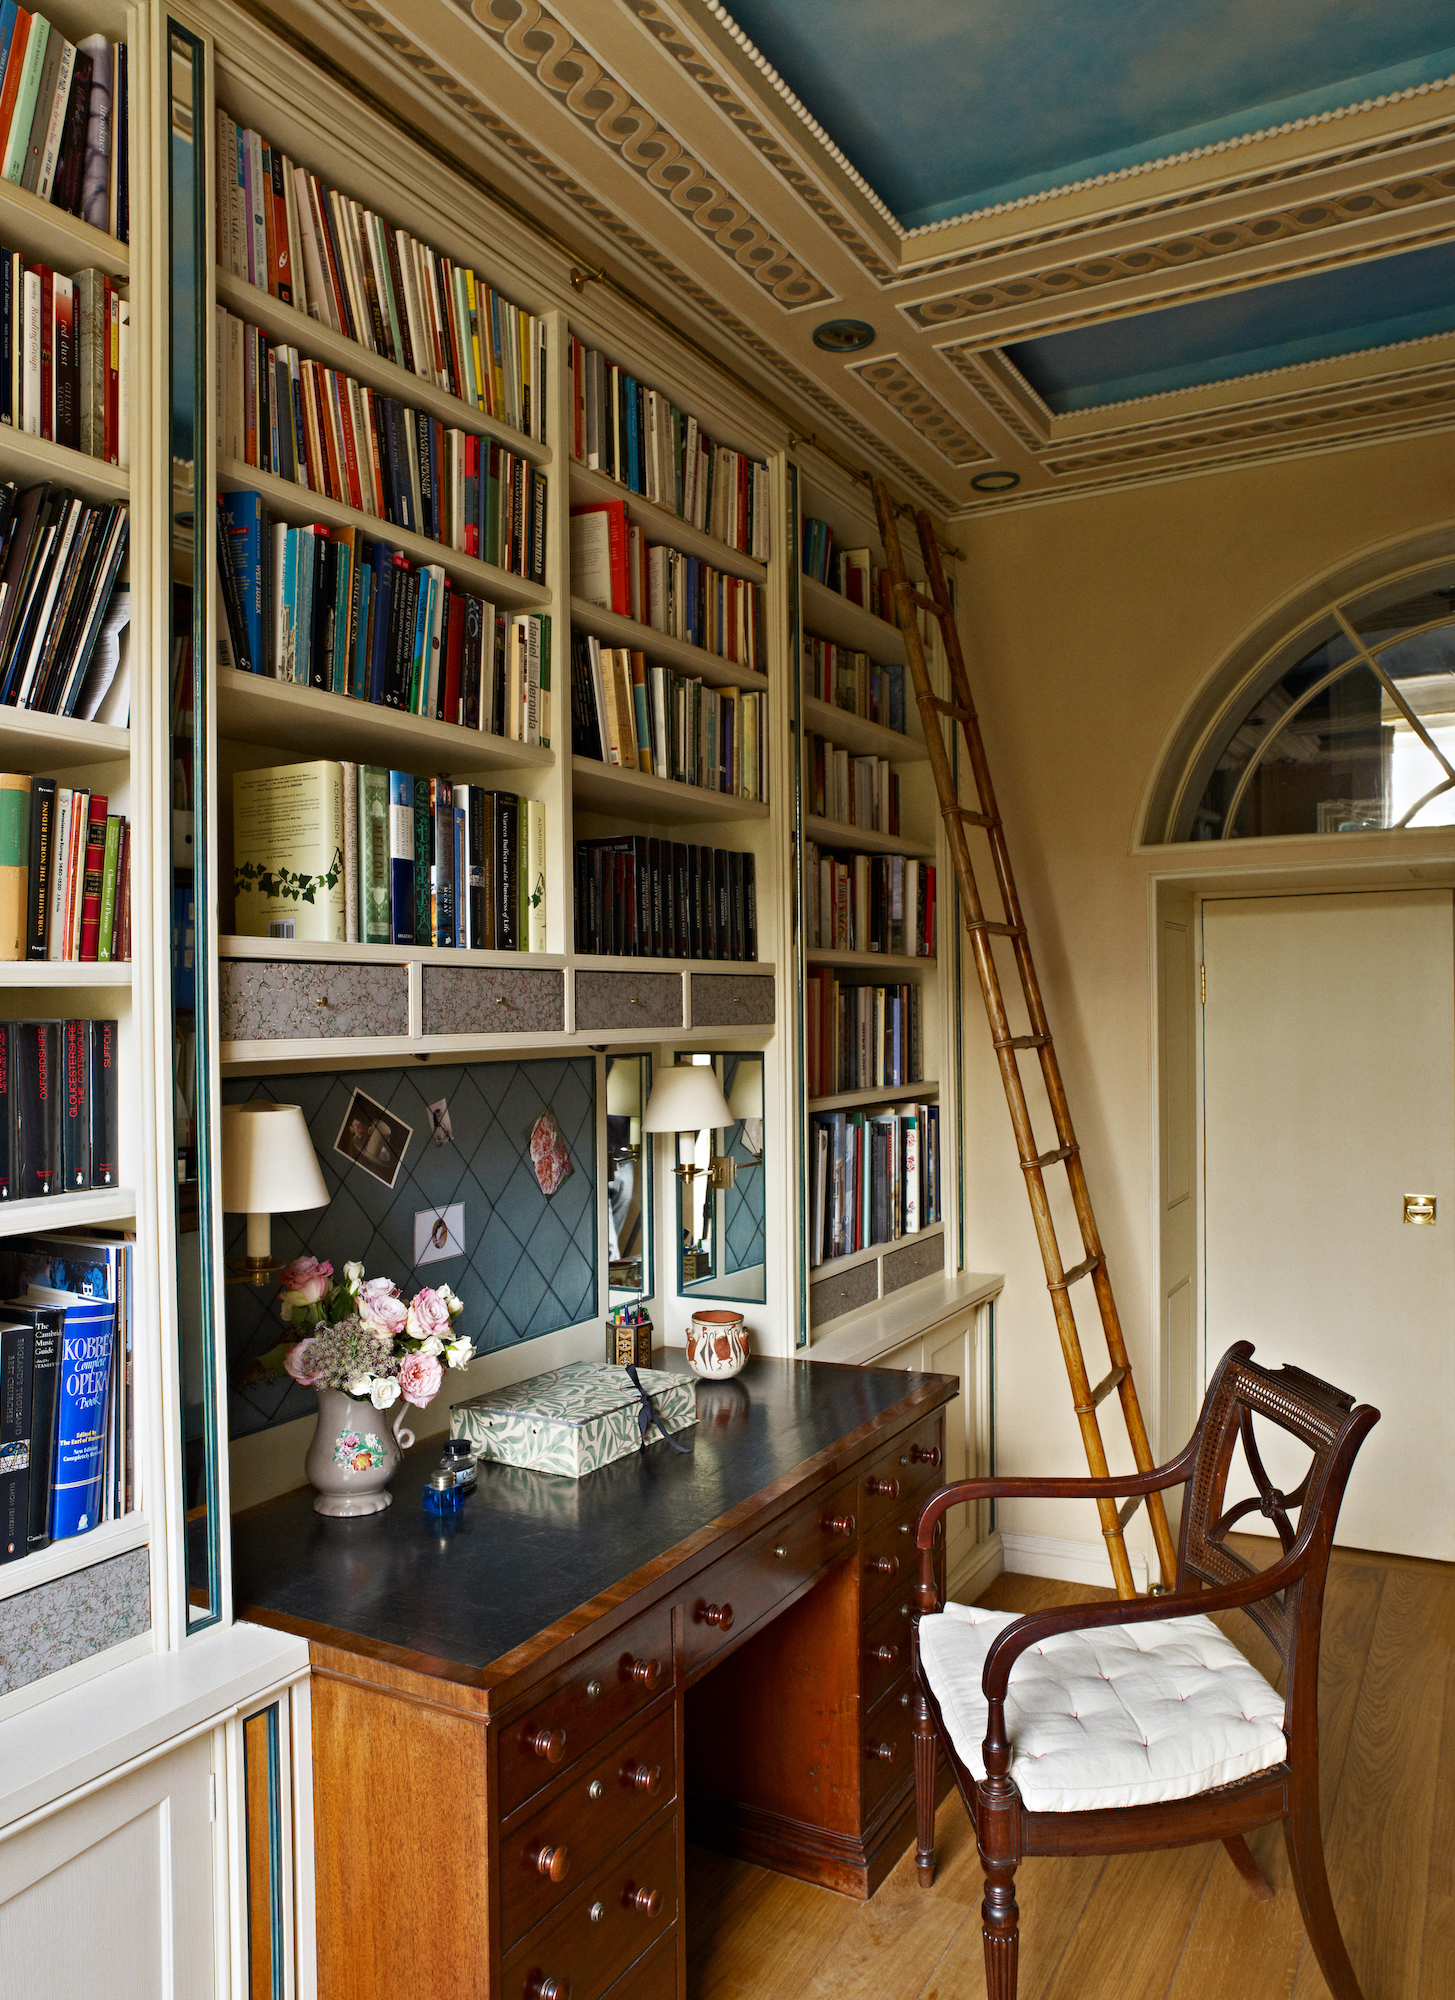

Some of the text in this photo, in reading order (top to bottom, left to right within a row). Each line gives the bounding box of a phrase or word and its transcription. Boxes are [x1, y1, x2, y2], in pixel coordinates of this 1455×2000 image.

[37, 24, 46, 48] VLADIMIR
[32, 49, 41, 74] NABOKOV
[59, 66, 70, 77] FROM
[58, 78, 66, 92] MARS
[98, 104, 108, 154] Brookner
[44, 150, 54, 176] JOHN GRAY
[374, 242, 384, 287] MORRISON
[404, 234, 413, 282] KRISHNAPUR
[366, 268, 384, 341] Blood River
[29, 306, 39, 373] Reading Groups
[60, 319, 70, 366] red dust
[352, 384, 360, 412] WILLIAM
[342, 410, 350, 434] STARS
[688, 422, 697, 446] Michael
[62, 511, 78, 550] HARDWICK HALL
[535, 502, 544, 574] FOUNTAINHEAD
[353, 568, 362, 603] HOME
[406, 577, 414, 601] BRITISH
[530, 622, 539, 658] daniel
[528, 680, 538, 729] deronda
[373, 824, 384, 879] MELLON
[106, 869, 114, 898] Churches
[104, 907, 112, 934] Florence
[38, 1028, 48, 1100] OXFORDSHIRE
[104, 1025, 112, 1068] SUFFOLK
[68, 1022, 78, 1118] GLOUCESTERSHIRE:
[35, 1347, 54, 1355] Guide
[6, 1376, 14, 1424] CHURCHES
[14, 1338, 26, 1436] ENGLAND'S THOUSAND
[66, 1370, 108, 1396] OPERA
[75, 1393, 102, 1410] Book
[62, 1454, 90, 1462] Completely
